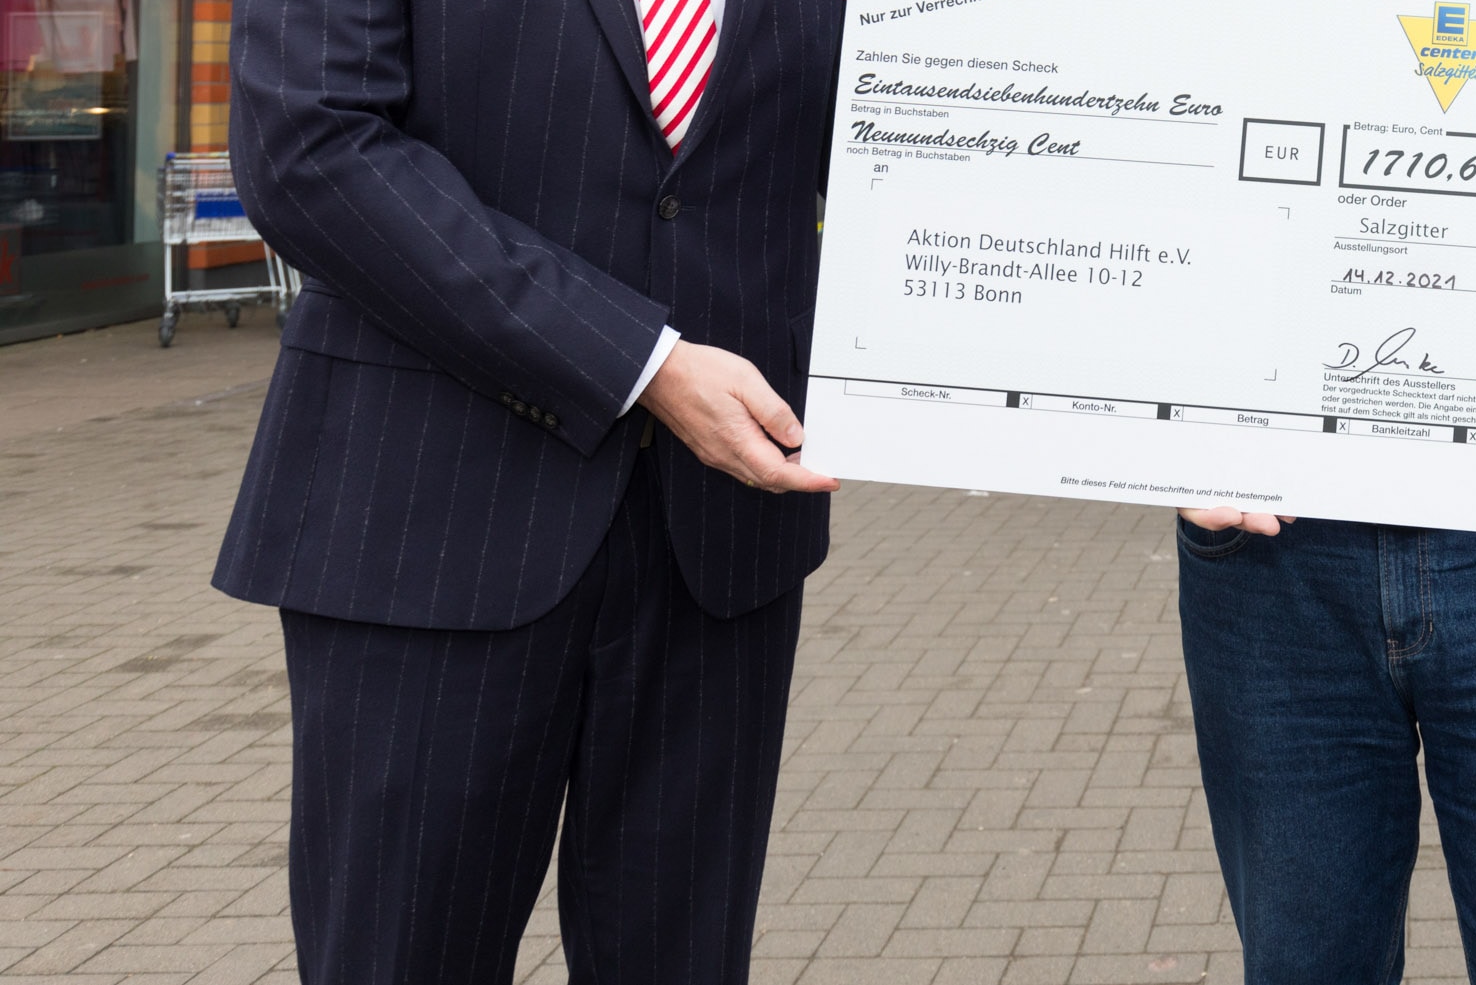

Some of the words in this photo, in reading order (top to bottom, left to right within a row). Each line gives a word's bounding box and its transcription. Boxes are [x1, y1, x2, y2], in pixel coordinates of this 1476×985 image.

[859, 11, 885, 26] Nur
[890, 4, 912, 20] zur
[1436, 35, 1464, 43] EDEKA
[856, 50, 898, 64] Zahlen
[901, 52, 922, 65] Sie
[925, 57, 964, 70] gegen
[967, 56, 1009, 71] diesen
[1012, 59, 1059, 74] Scheck
[853, 73, 1160, 115] Eintausendsiebenhundertzehn
[1168, 93, 1224, 117] Euro
[851, 103, 881, 114] Betrag
[883, 106, 892, 114] in
[894, 107, 949, 118] Buchstaben
[1354, 122, 1389, 134] Betrag:
[1392, 124, 1417, 135] Euro,
[1419, 126, 1443, 136] Cent
[851, 120, 1019, 157] Neunundsechzig
[1027, 133, 1081, 156] Cent
[846, 147, 869, 155] noch
[871, 147, 902, 158] Betrag
[905, 150, 913, 158] in
[915, 150, 971, 162] Buchstaben
[1265, 145, 1300, 160] EUR
[873, 163, 889, 173] an
[1337, 194, 1367, 205] oder
[1370, 195, 1407, 208] Order
[1360, 217, 1449, 239] Salzgitter
[907, 228, 971, 250] Aktion
[979, 233, 1102, 259] Deutschland
[1109, 243, 1151, 262] Hilft
[1158, 248, 1192, 266] e.V.
[1333, 242, 1408, 255] Ausstellungsort
[905, 254, 1078, 283] Willy-Brandt-Allee
[1087, 267, 1143, 288] 10-12
[1343, 268, 1456, 290] 14.12.2021
[903, 279, 966, 300] 53113
[974, 284, 1023, 304] Bonn
[1330, 285, 1362, 295] Datum
[1324, 373, 1380, 385] Unterschrift
[1383, 377, 1400, 387] des
[1403, 379, 1456, 390] Ausstellers
[1323, 384, 1337, 392] Der
[1339, 386, 1390, 397] vorgedruckte
[1392, 389, 1437, 400] Schecktext
[1438, 393, 1455, 401] darf
[1456, 394, 1476, 403] nicht
[1322, 395, 1340, 403] oder
[1341, 397, 1383, 407] gestrichen
[1385, 400, 1415, 409] werden.
[1418, 402, 1432, 410] Die
[1433, 403, 1464, 413] Angabe
[901, 387, 952, 400] Scheck-Nr.
[1022, 397, 1030, 406] X
[1072, 401, 1117, 413] Konto-Nr.
[1173, 409, 1181, 418] X
[1237, 414, 1269, 426] Betrag
[1339, 422, 1346, 431] X
[1371, 424, 1430, 438] Bankleitzahl
[1469, 432, 1476, 441] X
[1321, 405, 1337, 413] frist
[1353, 407, 1370, 415] dem
[1372, 409, 1401, 418] Scheck
[1403, 411, 1415, 420] gilt
[1431, 414, 1450, 422] nicht
[1060, 476, 1080, 485] Bitte
[1081, 478, 1107, 488] dieses
[1108, 480, 1126, 489] Feld
[1128, 482, 1148, 491] nicht
[1149, 484, 1195, 495] beschriften
[1196, 488, 1212, 496] und
[1213, 489, 1234, 498] nicht
[1235, 491, 1283, 502] bestempeln
